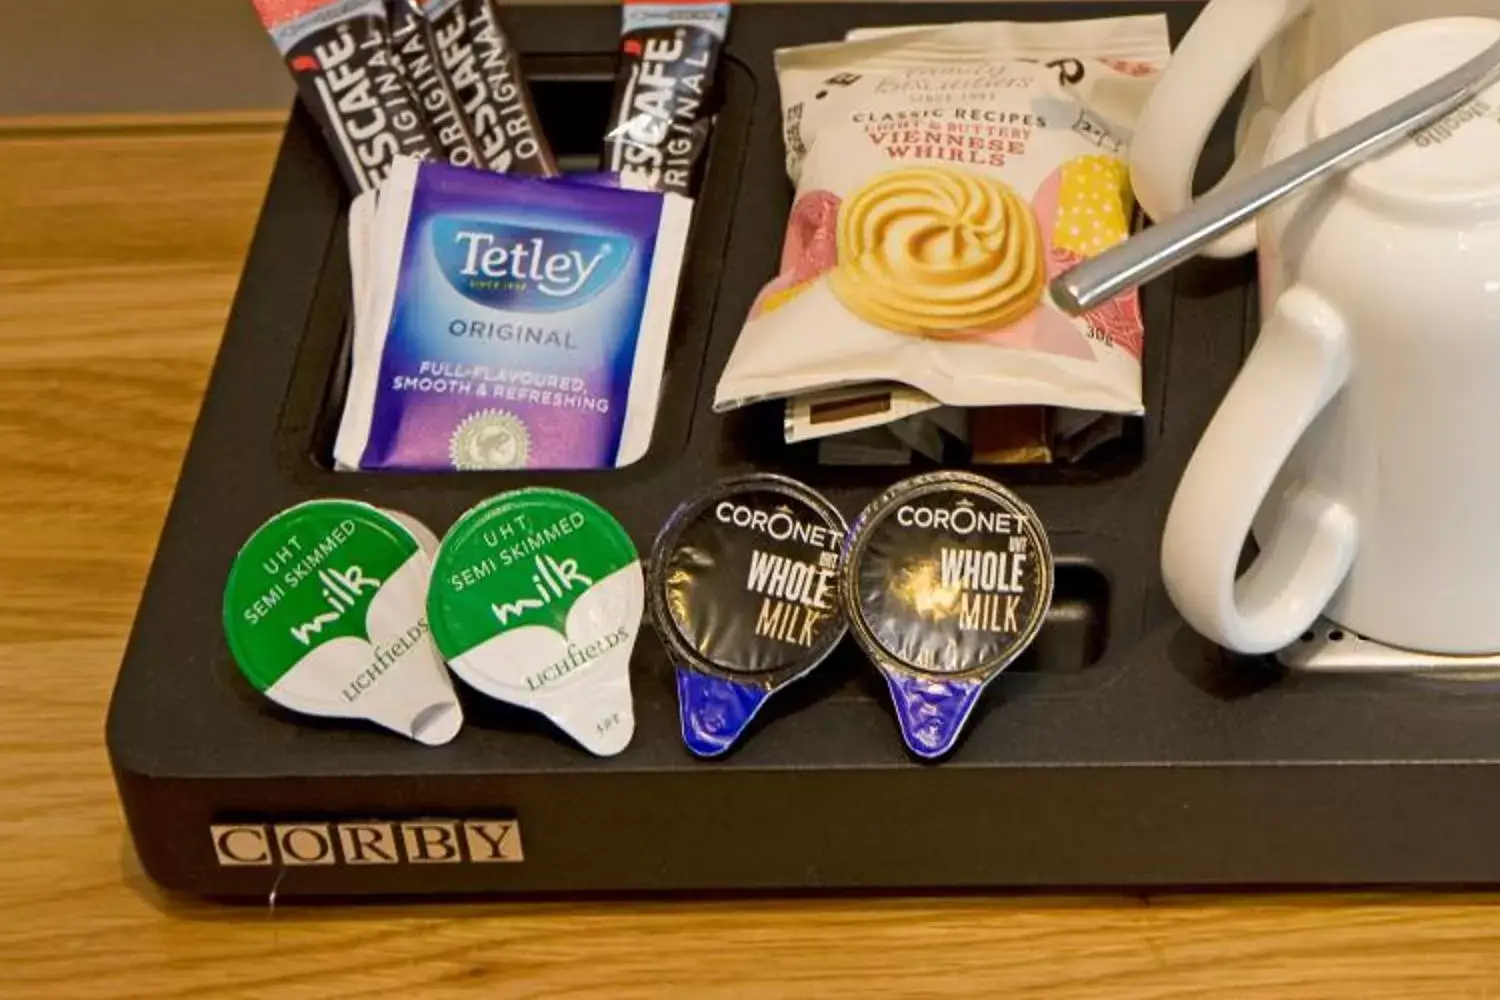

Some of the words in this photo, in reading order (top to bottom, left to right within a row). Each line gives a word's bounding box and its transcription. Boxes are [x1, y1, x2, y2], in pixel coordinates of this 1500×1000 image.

[393, 13, 473, 167] ORIGINAL
[468, 4, 539, 159] ORIGINAL
[663, 49, 710, 187] RIGINAL
[853, 108, 944, 122] CLASSIC
[955, 108, 1047, 128] RECIPES
[869, 130, 1026, 155] VIENNESE
[886, 145, 1006, 167] WHIRLS
[454, 230, 613, 297] Tetley
[448, 319, 578, 350] ORIGINAL
[392, 376, 471, 394] SMOOTH
[475, 385, 487, 397] &
[493, 385, 610, 413] REFRESHING
[483, 513, 528, 549] UHT
[715, 501, 844, 550] CORONET
[897, 504, 1028, 535] CORONET
[243, 587, 286, 627] SEMI
[284, 518, 357, 588] SKIMMED
[263, 535, 305, 575] UHT
[451, 559, 497, 592] SEMI
[500, 510, 586, 563] SKIMMED
[941, 547, 1027, 594] WHOLE
[492, 555, 593, 627] milk
[747, 549, 836, 609] WHOLE
[290, 562, 381, 647] milk
[755, 597, 821, 649] MILK
[959, 592, 1021, 633] MILK
[217, 825, 513, 863] CORBY
